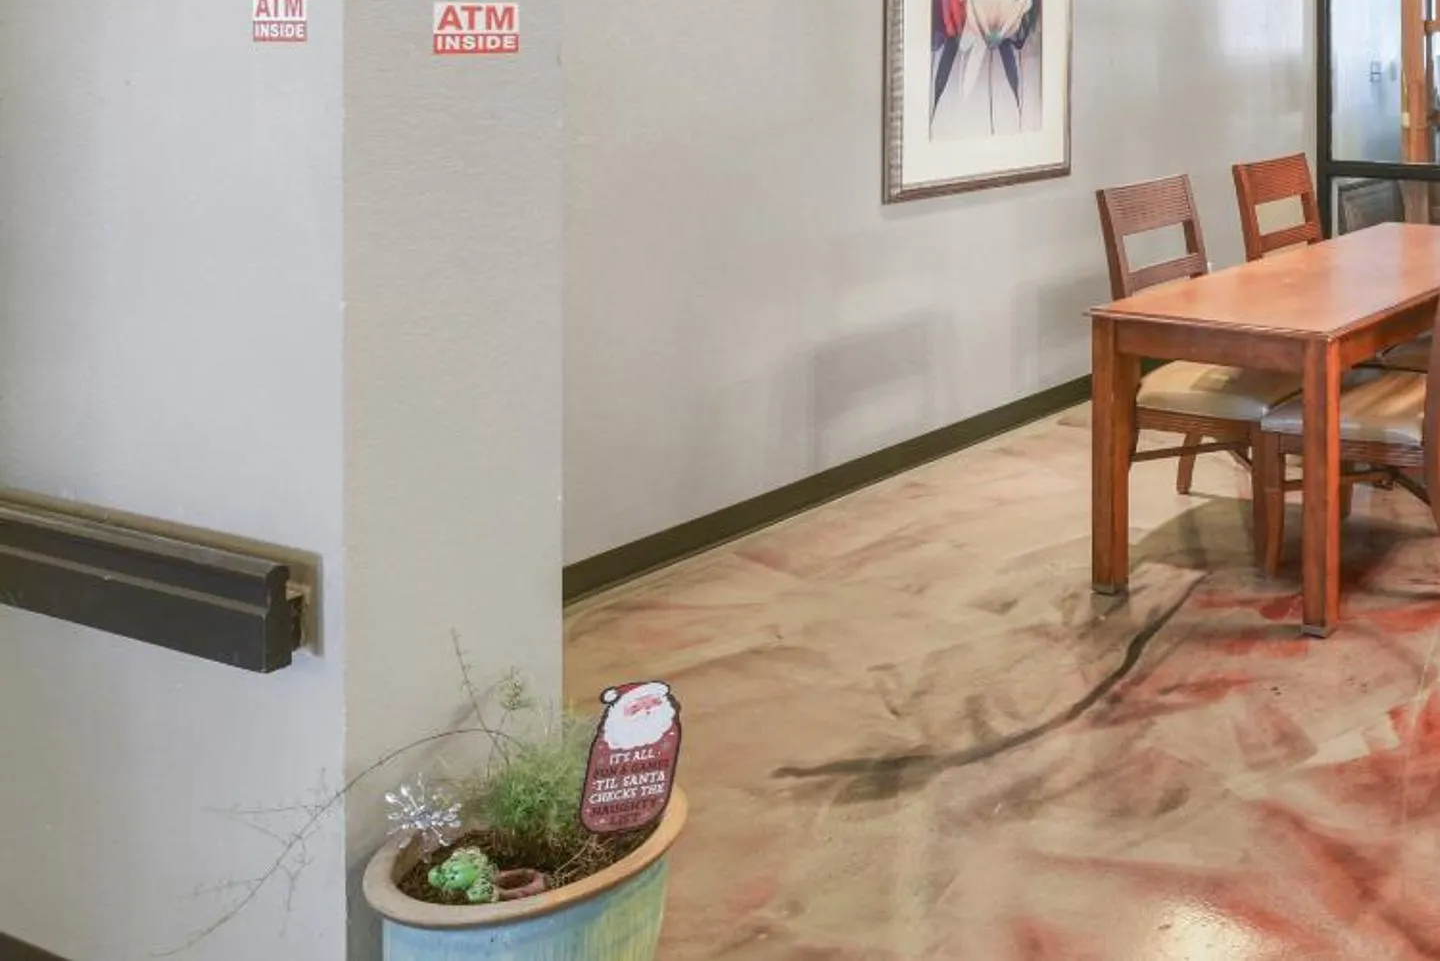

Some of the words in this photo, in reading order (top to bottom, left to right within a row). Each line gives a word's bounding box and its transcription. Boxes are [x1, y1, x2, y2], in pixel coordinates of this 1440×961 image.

[437, 4, 514, 31] ATM
[255, 23, 304, 38] INSIDE
[436, 35, 517, 50] INSIDE
[632, 748, 655, 761] ALL
[623, 770, 665, 787] SANTA
[640, 783, 665, 797] THE
